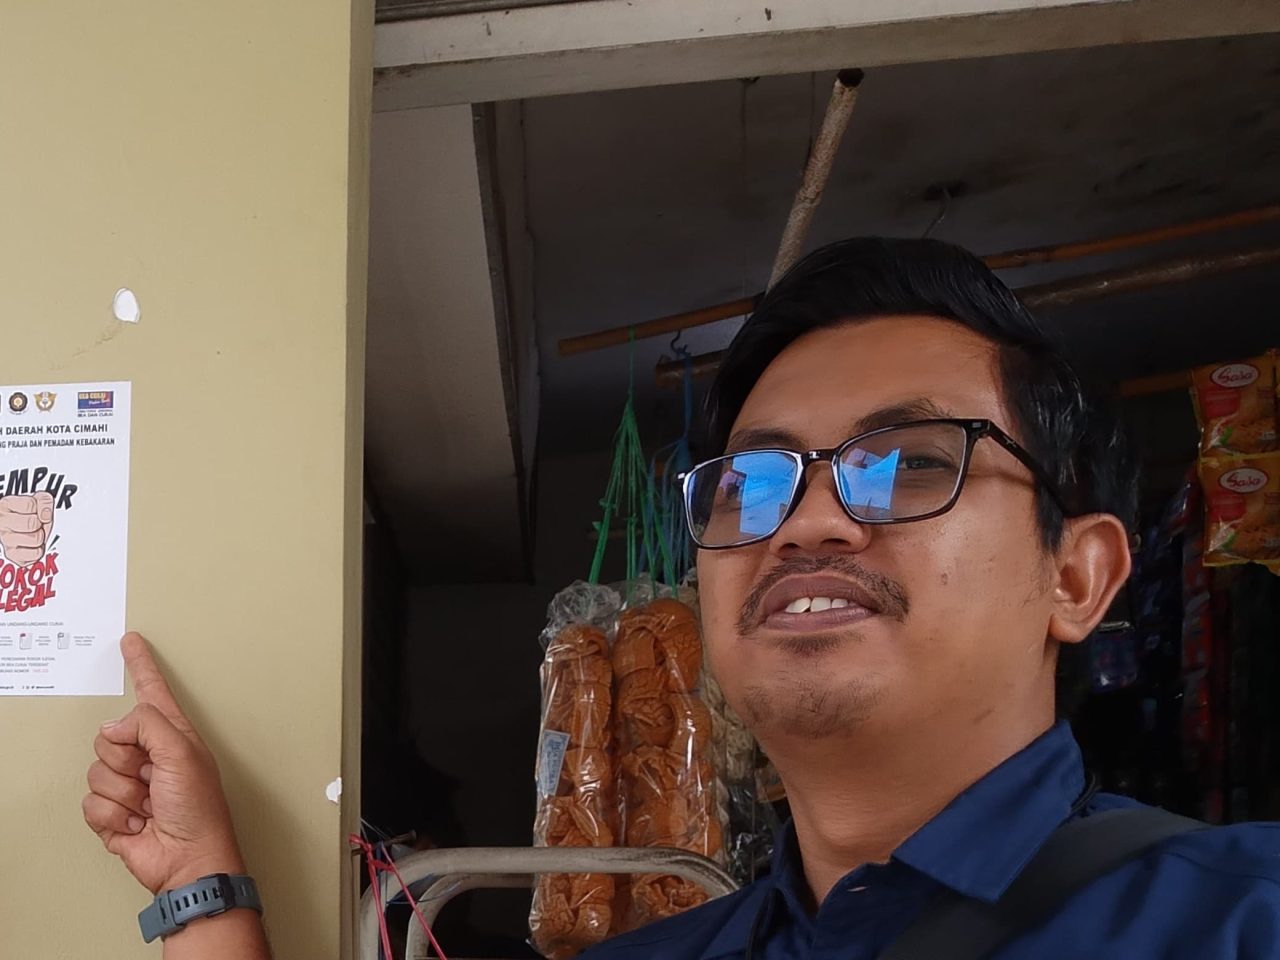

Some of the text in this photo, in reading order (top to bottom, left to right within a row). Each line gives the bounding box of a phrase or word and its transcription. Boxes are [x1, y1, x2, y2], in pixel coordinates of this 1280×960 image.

[6, 426, 43, 436] DAERAH
[46, 425, 71, 434] KOTA
[74, 424, 108, 433] CIMAHI
[8, 440, 28, 448] PRAJA
[44, 439, 74, 447] PEMADAM
[76, 438, 115, 446] KEBAKARAN
